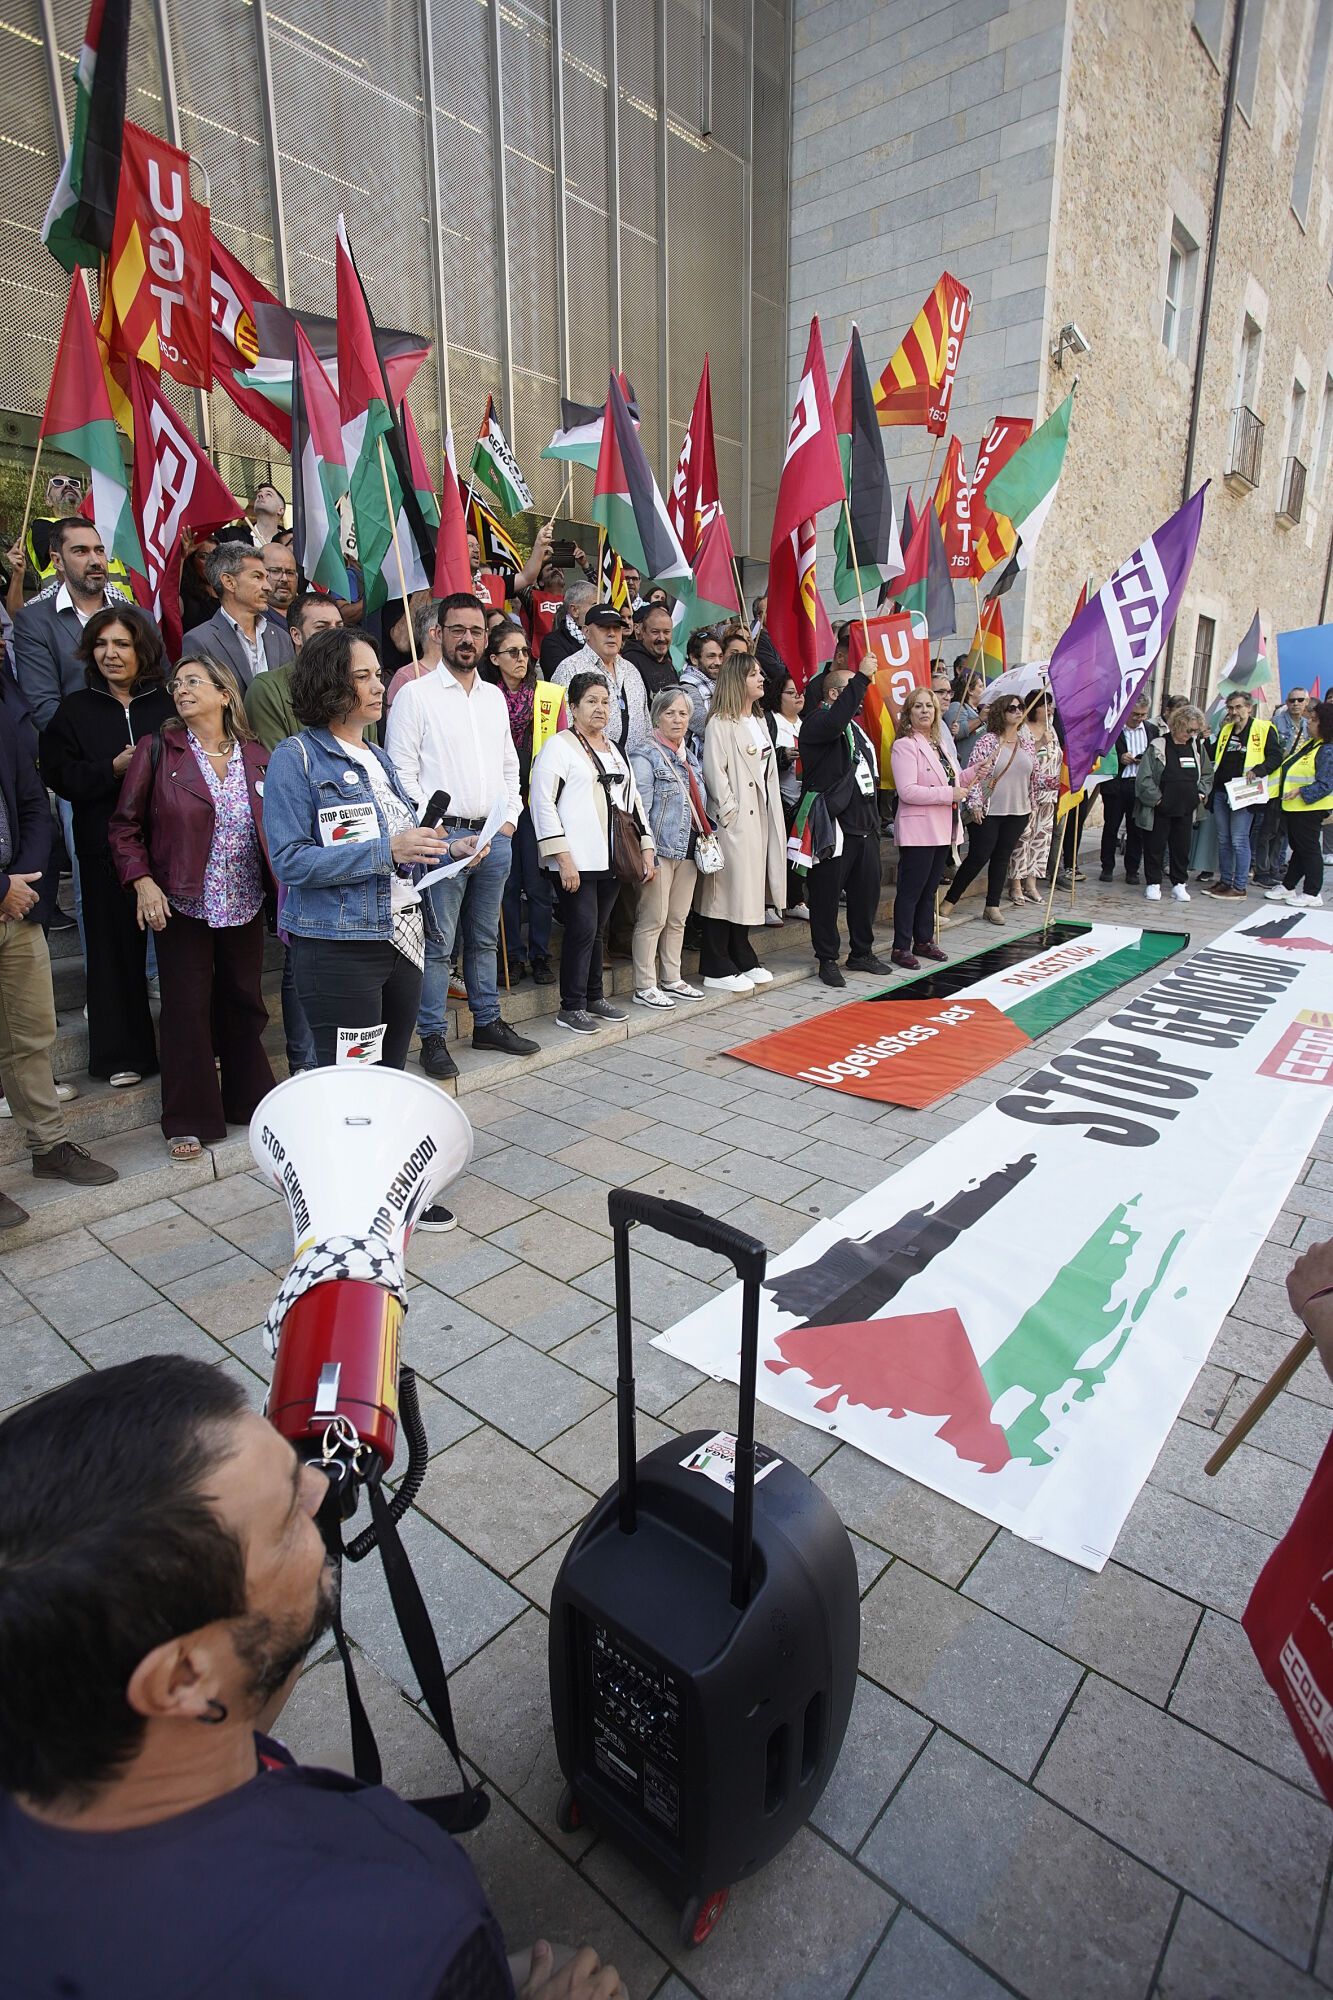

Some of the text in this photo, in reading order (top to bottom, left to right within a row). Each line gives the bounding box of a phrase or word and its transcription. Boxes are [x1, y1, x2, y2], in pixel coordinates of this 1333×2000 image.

[540, 701, 552, 713] GT
[320, 811, 338, 823] STOP
[340, 806, 374, 819] GENOCIDI
[1000, 944, 1099, 988] PALESTINA
[340, 1031, 359, 1041] STOP
[796, 1004, 976, 1084] Ugetistes per
[995, 947, 1307, 1147] STOP GENOCIDI
[261, 1125, 312, 1239] STOP GENOCIDI
[368, 1134, 438, 1245] TOP GENOCIDI
[704, 1447, 734, 1464] VAGA
